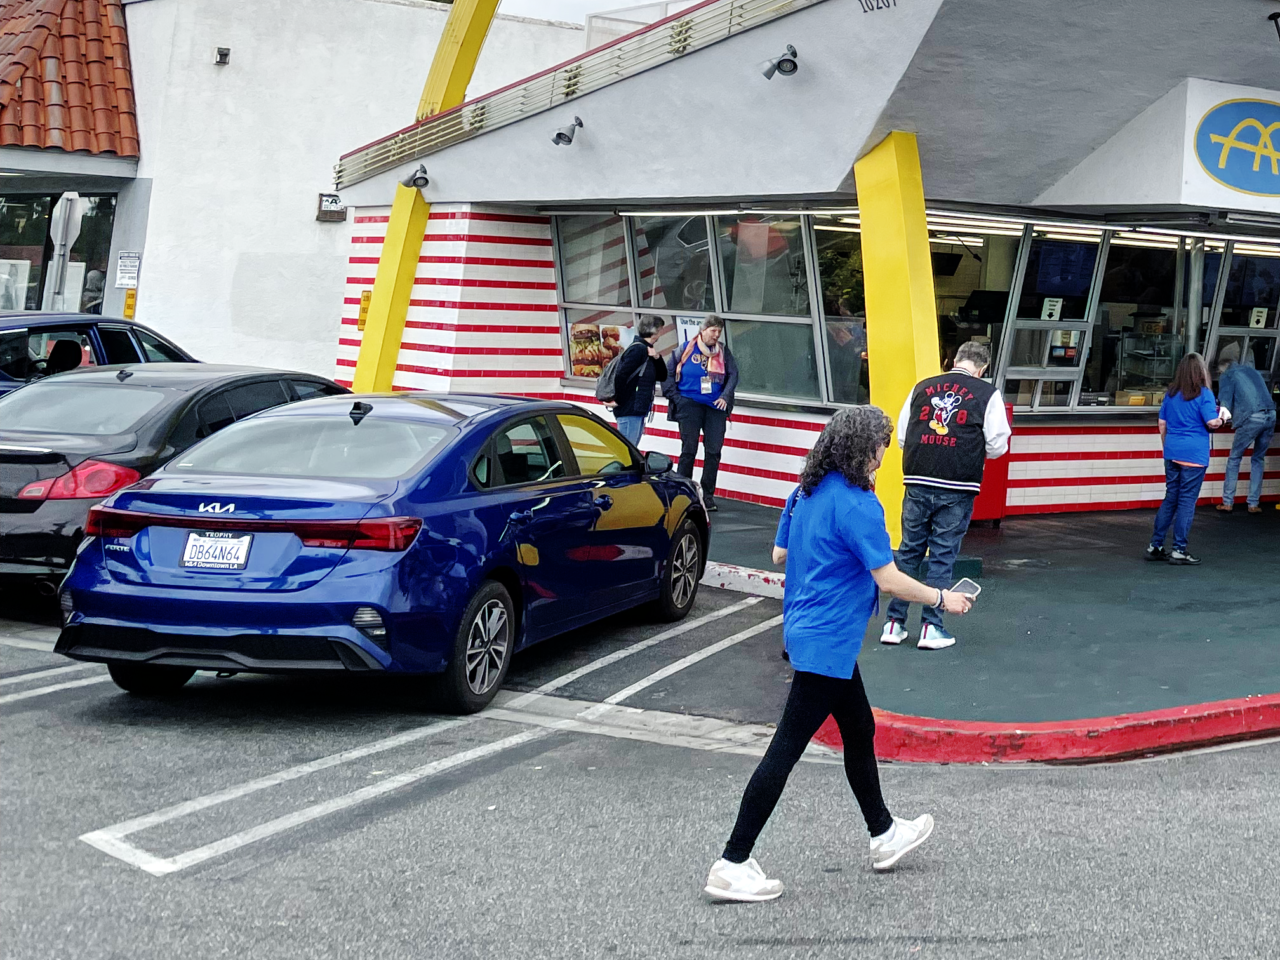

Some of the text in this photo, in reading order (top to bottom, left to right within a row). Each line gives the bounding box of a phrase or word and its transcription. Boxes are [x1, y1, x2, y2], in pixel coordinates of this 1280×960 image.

[925, 383, 974, 401] MICKEY
[919, 405, 930, 420] 2
[956, 409, 968, 425] 8
[920, 434, 957, 447] MOUSE
[198, 502, 236, 514] KIA
[105, 544, 130, 553] FORTE
[188, 544, 241, 561] DB64N64
